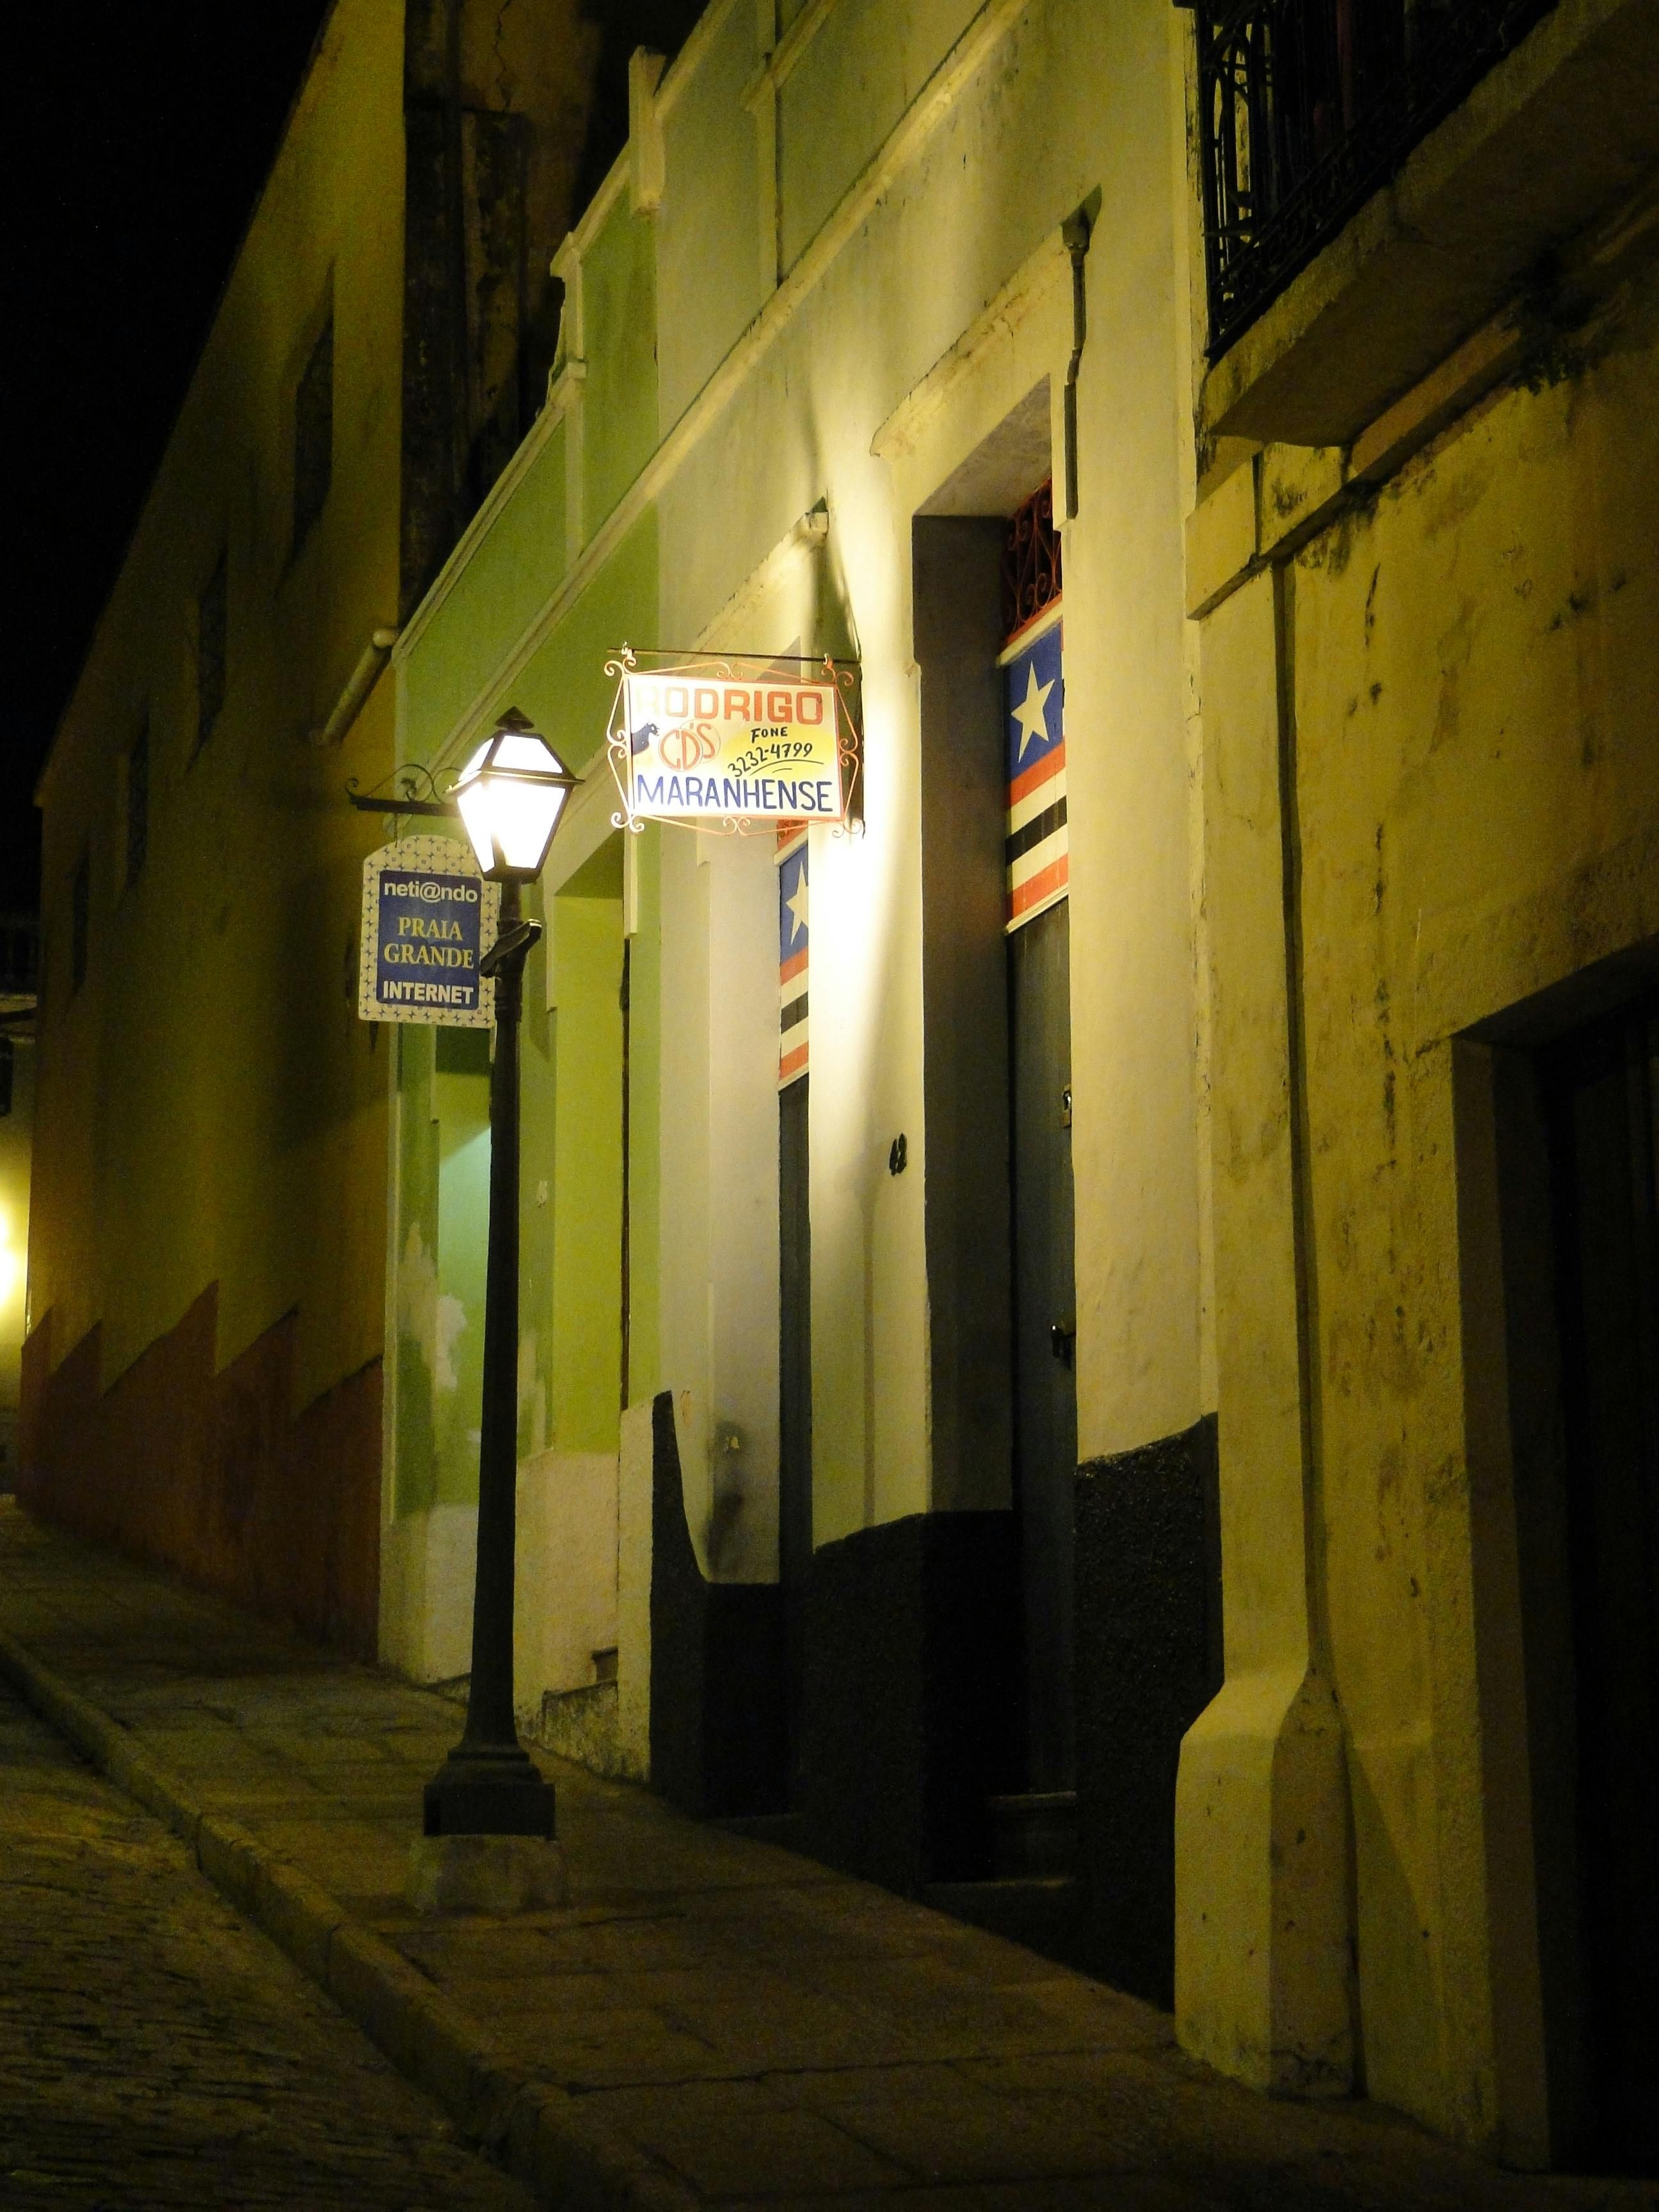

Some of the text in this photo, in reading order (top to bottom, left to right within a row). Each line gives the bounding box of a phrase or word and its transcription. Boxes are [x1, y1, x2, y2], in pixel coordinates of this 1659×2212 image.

[636, 685, 823, 725] RODRIGO
[751, 726, 788, 743] FONE
[728, 742, 813, 777] 3232-4799
[637, 774, 833, 812] MARANHENSE
[384, 881, 478, 903] neti@ndo
[397, 917, 463, 941] PRAIA
[384, 943, 474, 969] GRANDE
[383, 981, 474, 1004] INTERNET
